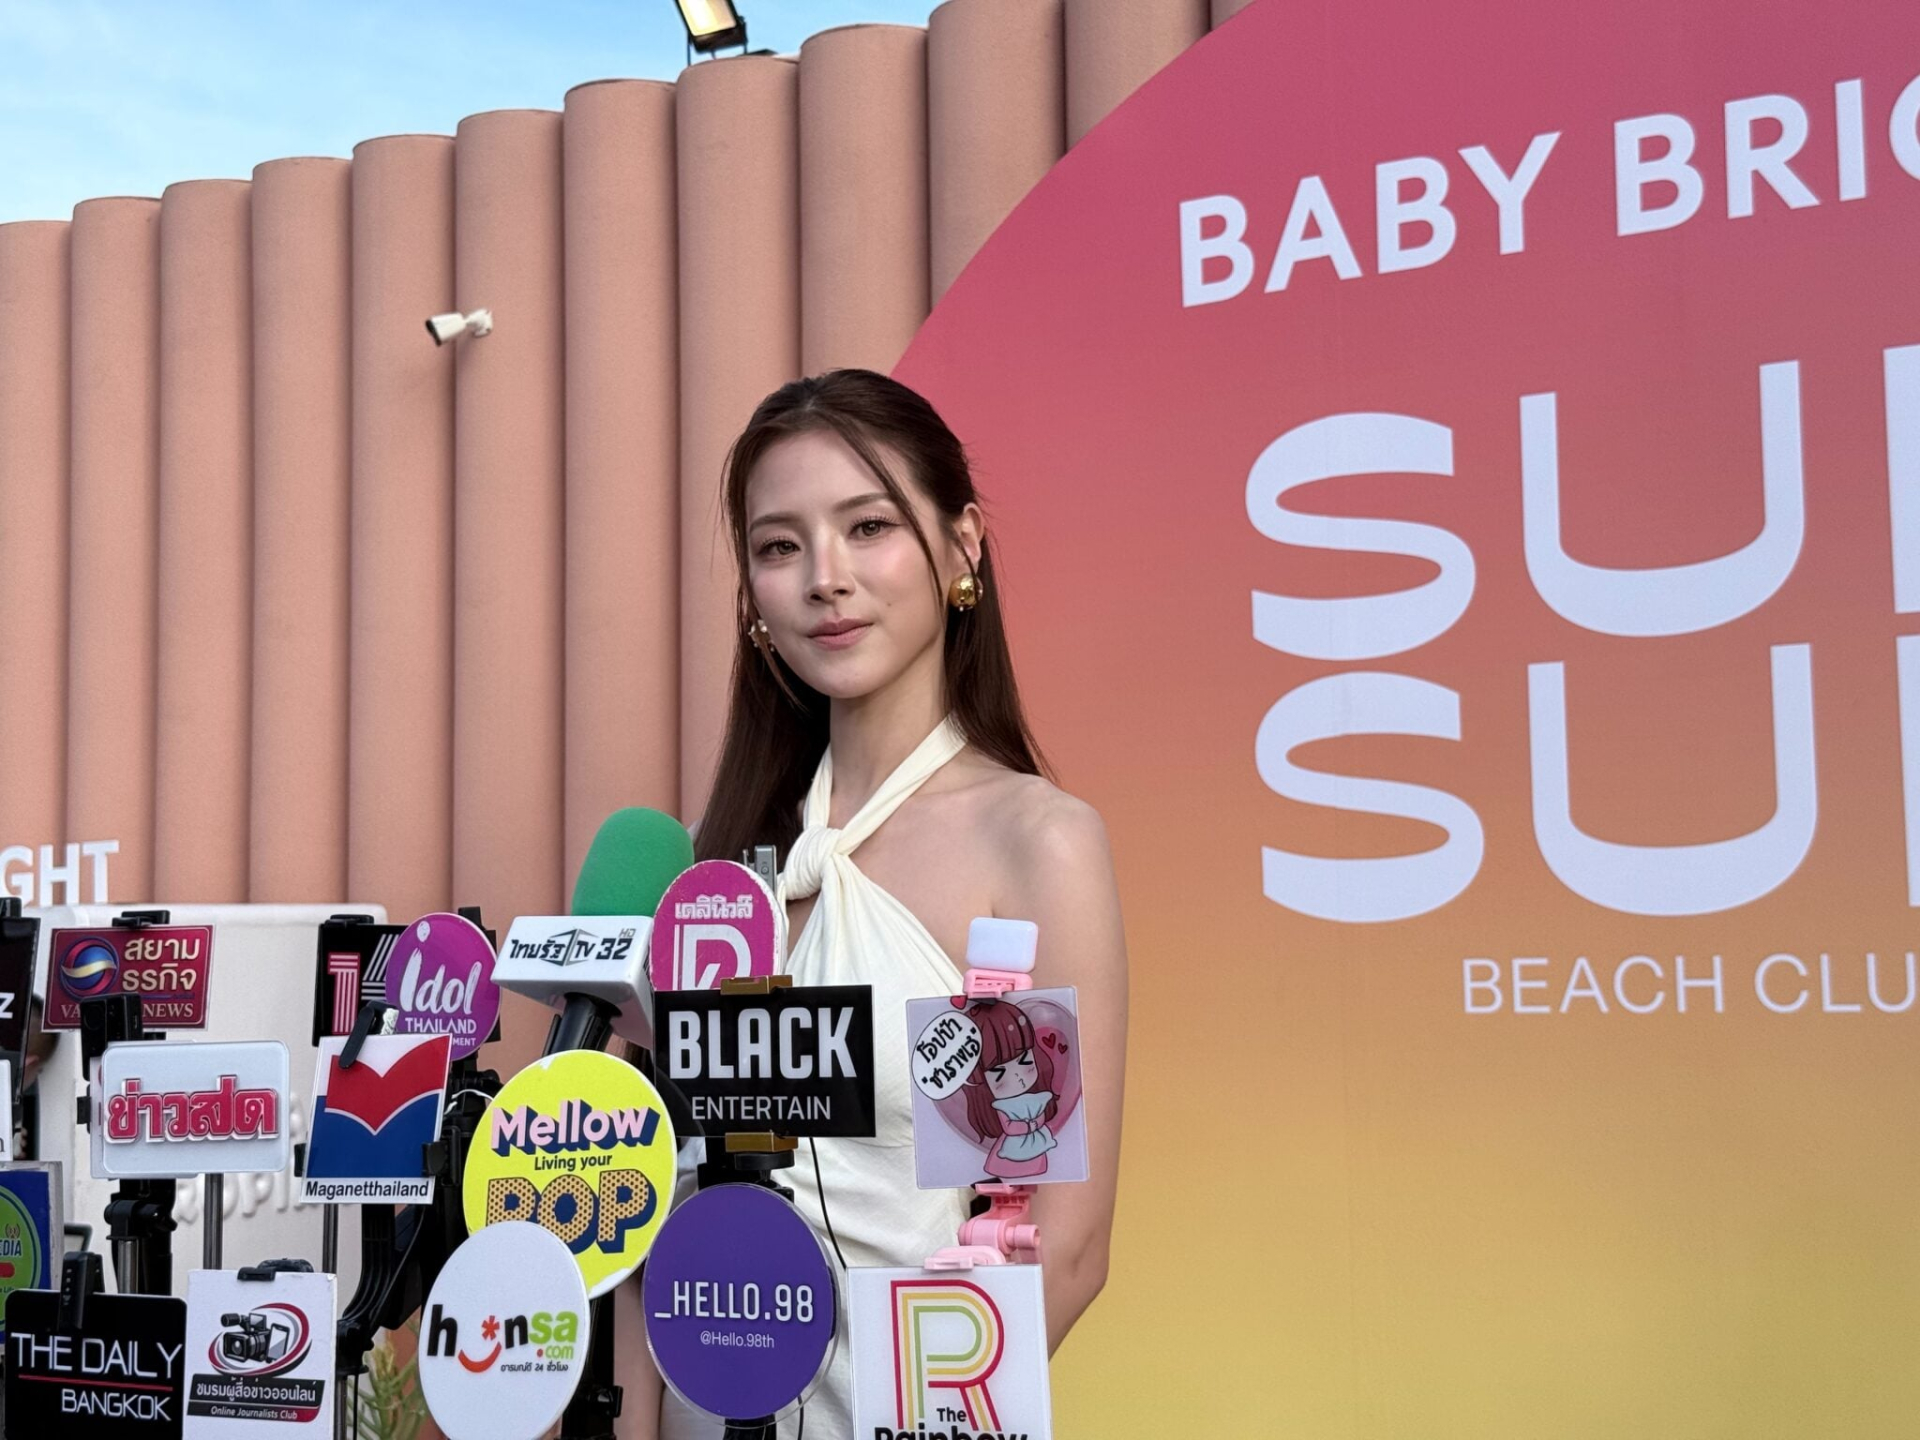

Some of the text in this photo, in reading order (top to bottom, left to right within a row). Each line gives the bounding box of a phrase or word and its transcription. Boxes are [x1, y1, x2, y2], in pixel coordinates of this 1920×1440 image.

[1179, 130, 1562, 308] BABY
[1245, 345, 1920, 660] SU
[1255, 635, 1920, 923] SU
[124, 938, 200, 960] สยาม
[575, 938, 633, 960] TV 32
[122, 963, 197, 991] ธรกิจ
[1463, 952, 1917, 1014] BEACH CLU
[143, 1003, 194, 1018] NEWS
[405, 1017, 477, 1034] THAILAND
[668, 1007, 857, 1079] BLACK
[105, 1075, 280, 1143] ข่าวสด
[691, 1096, 831, 1120] ENTERTAIN
[490, 1098, 660, 1157] Mellow
[534, 1153, 612, 1171] Living your
[305, 1180, 429, 1201] Maganetthailand
[486, 1168, 657, 1254] POP
[0, 1240, 22, 1256] DIA
[654, 1280, 814, 1323] _HELLO.98
[700, 1330, 775, 1348] @Hello.98th
[11, 1331, 183, 1379] THE DAILY
[534, 1363, 544, 1372] 24
[196, 1376, 317, 1402] ชมรมผู้สื่อข่าวออนไลน์
[61, 1388, 172, 1421] BANGKOK
[210, 1405, 298, 1420] Online Journalists Club
[936, 1407, 967, 1422] The
